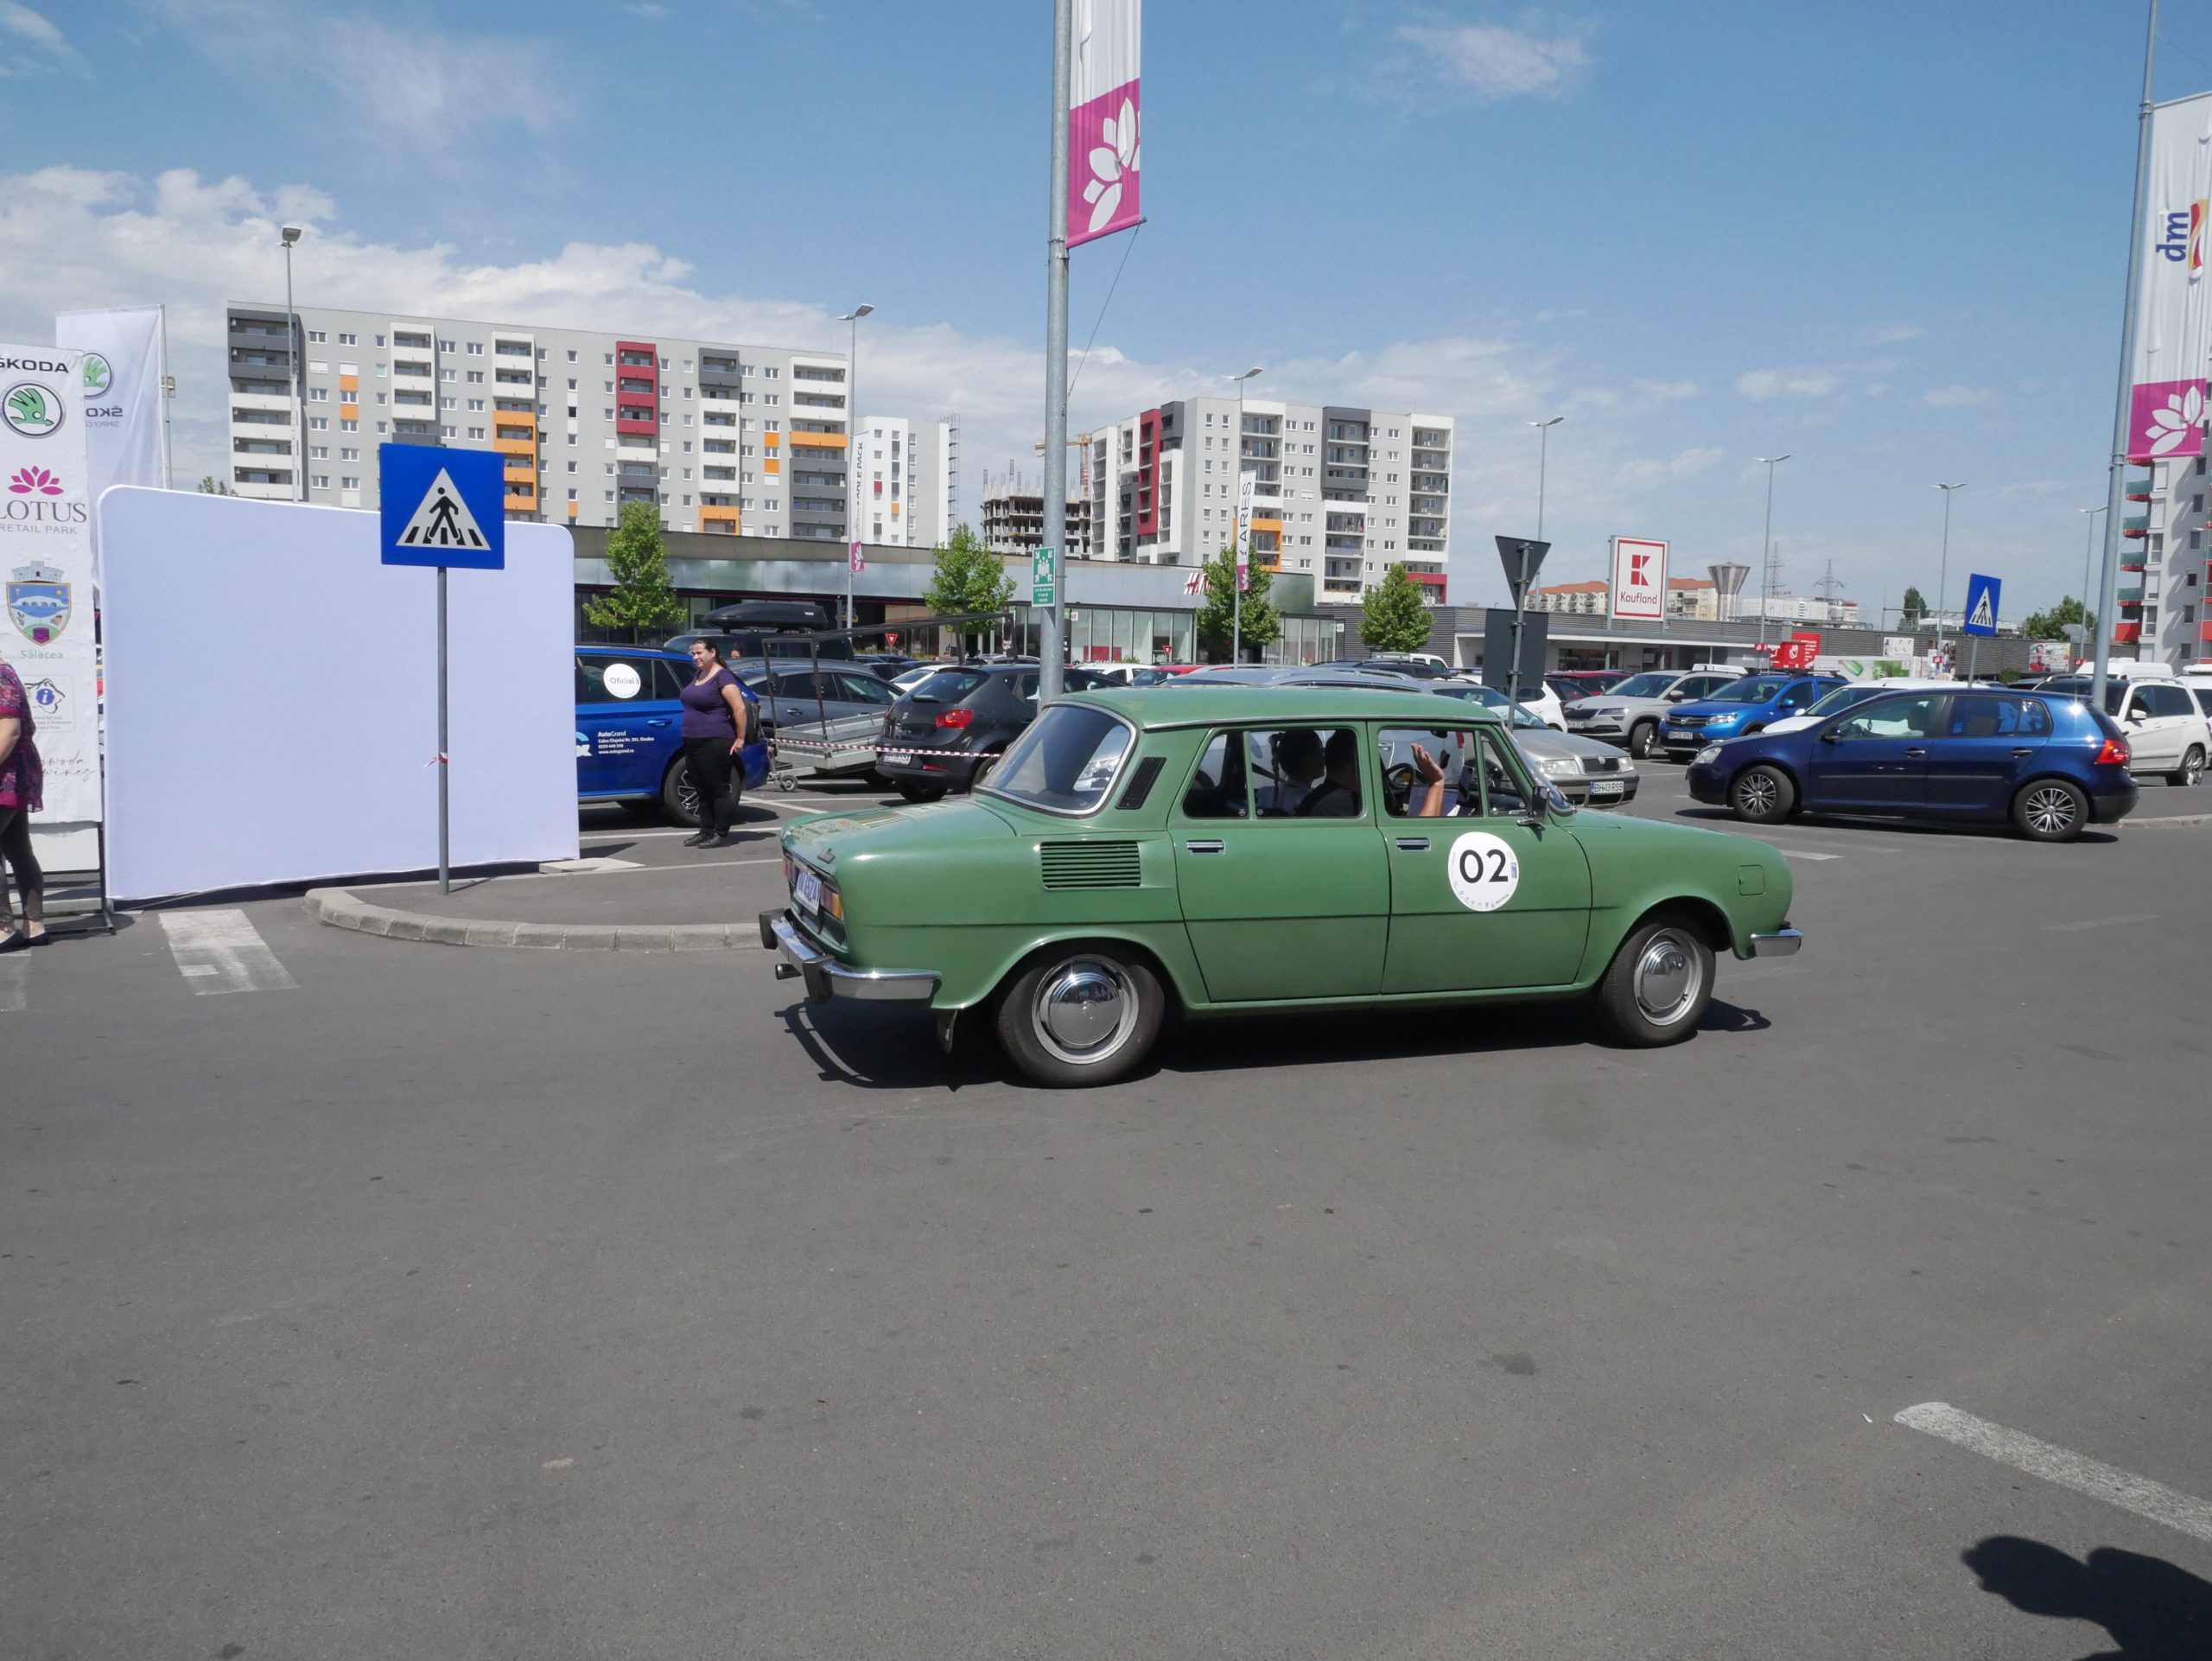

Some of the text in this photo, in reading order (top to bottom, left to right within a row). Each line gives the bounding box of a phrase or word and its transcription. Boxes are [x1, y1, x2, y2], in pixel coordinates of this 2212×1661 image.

[2156, 212, 2190, 262] dm
[46, 525, 77, 534] PARK
[1620, 591, 1658, 604] Kaufland
[1459, 849, 1509, 884] 02
